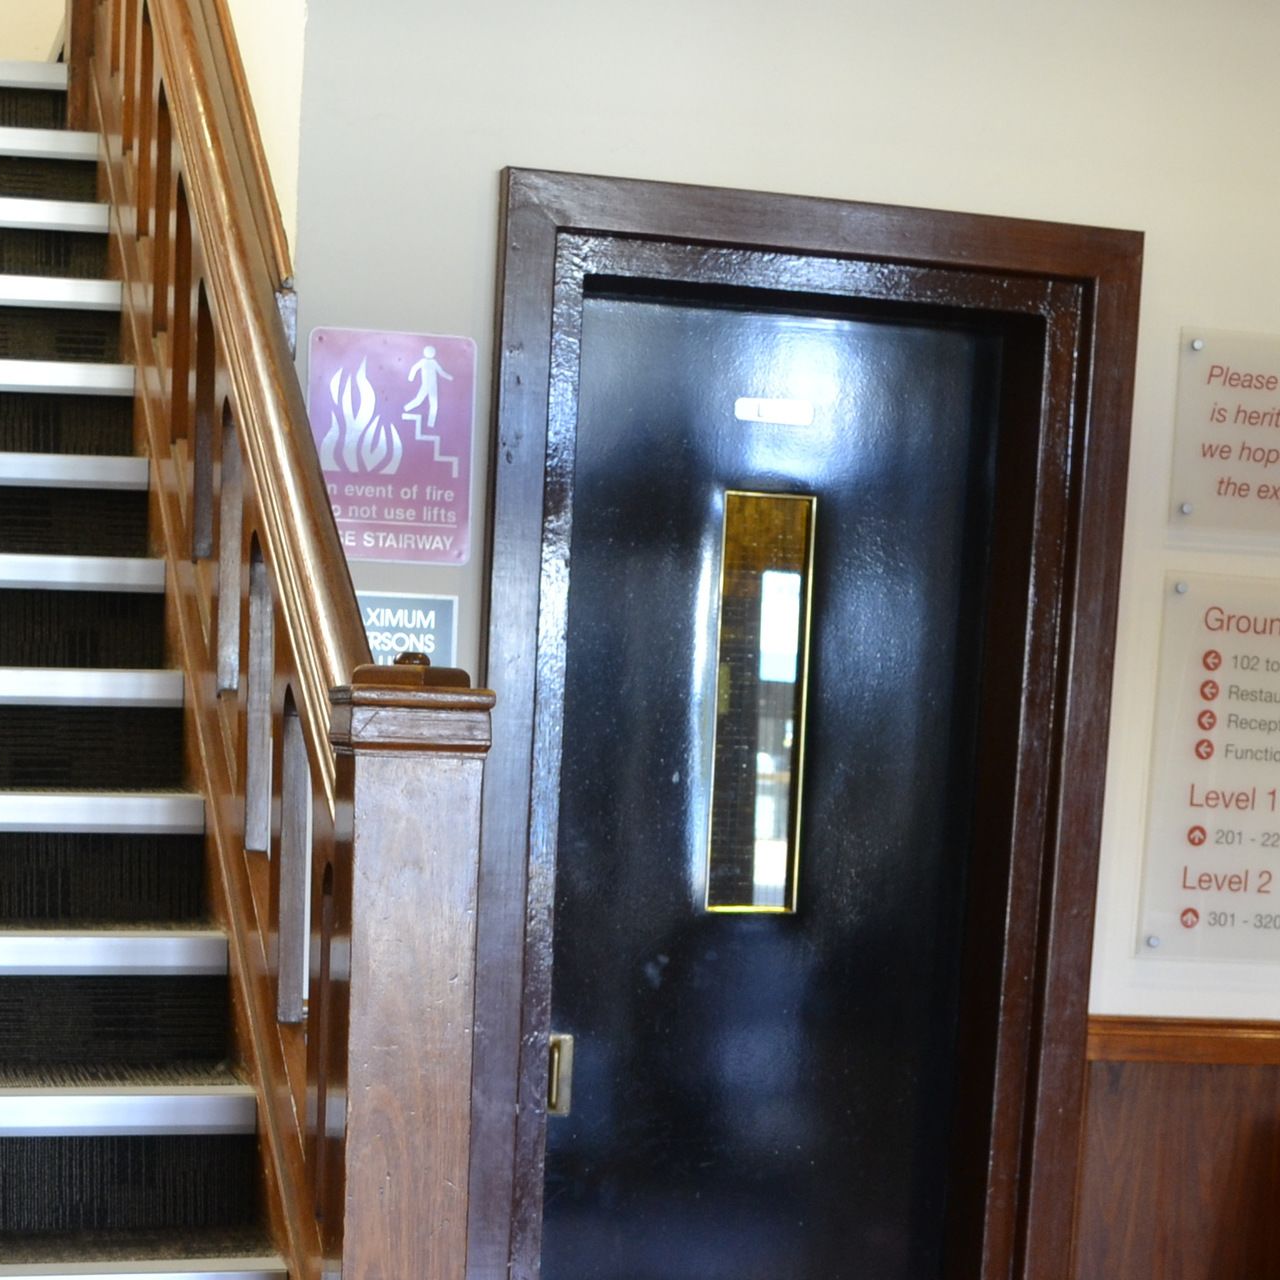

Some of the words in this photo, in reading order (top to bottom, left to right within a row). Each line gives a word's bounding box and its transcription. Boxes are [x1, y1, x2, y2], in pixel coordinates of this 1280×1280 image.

[1207, 364, 1279, 391] Please
[1210, 402, 1228, 424] is
[1201, 442, 1232, 460] we
[345, 484, 393, 499] event
[400, 484, 418, 500] of
[426, 486, 455, 502] fire
[1217, 477, 1250, 498] the
[348, 504, 377, 519] not
[384, 508, 416, 522] use
[423, 506, 457, 524] lifts
[363, 531, 454, 551] STAIRWAY
[363, 607, 436, 630] XIMUM
[367, 631, 436, 654] RSONS
[1232, 654, 1260, 672] 102
[1265, 658, 1280, 673] to
[1189, 783, 1257, 812] Level
[1267, 787, 1277, 812] 1
[1215, 829, 1243, 846] 201
[1182, 865, 1249, 893] Level
[1257, 870, 1273, 894] 2
[1208, 911, 1236, 928] 301
